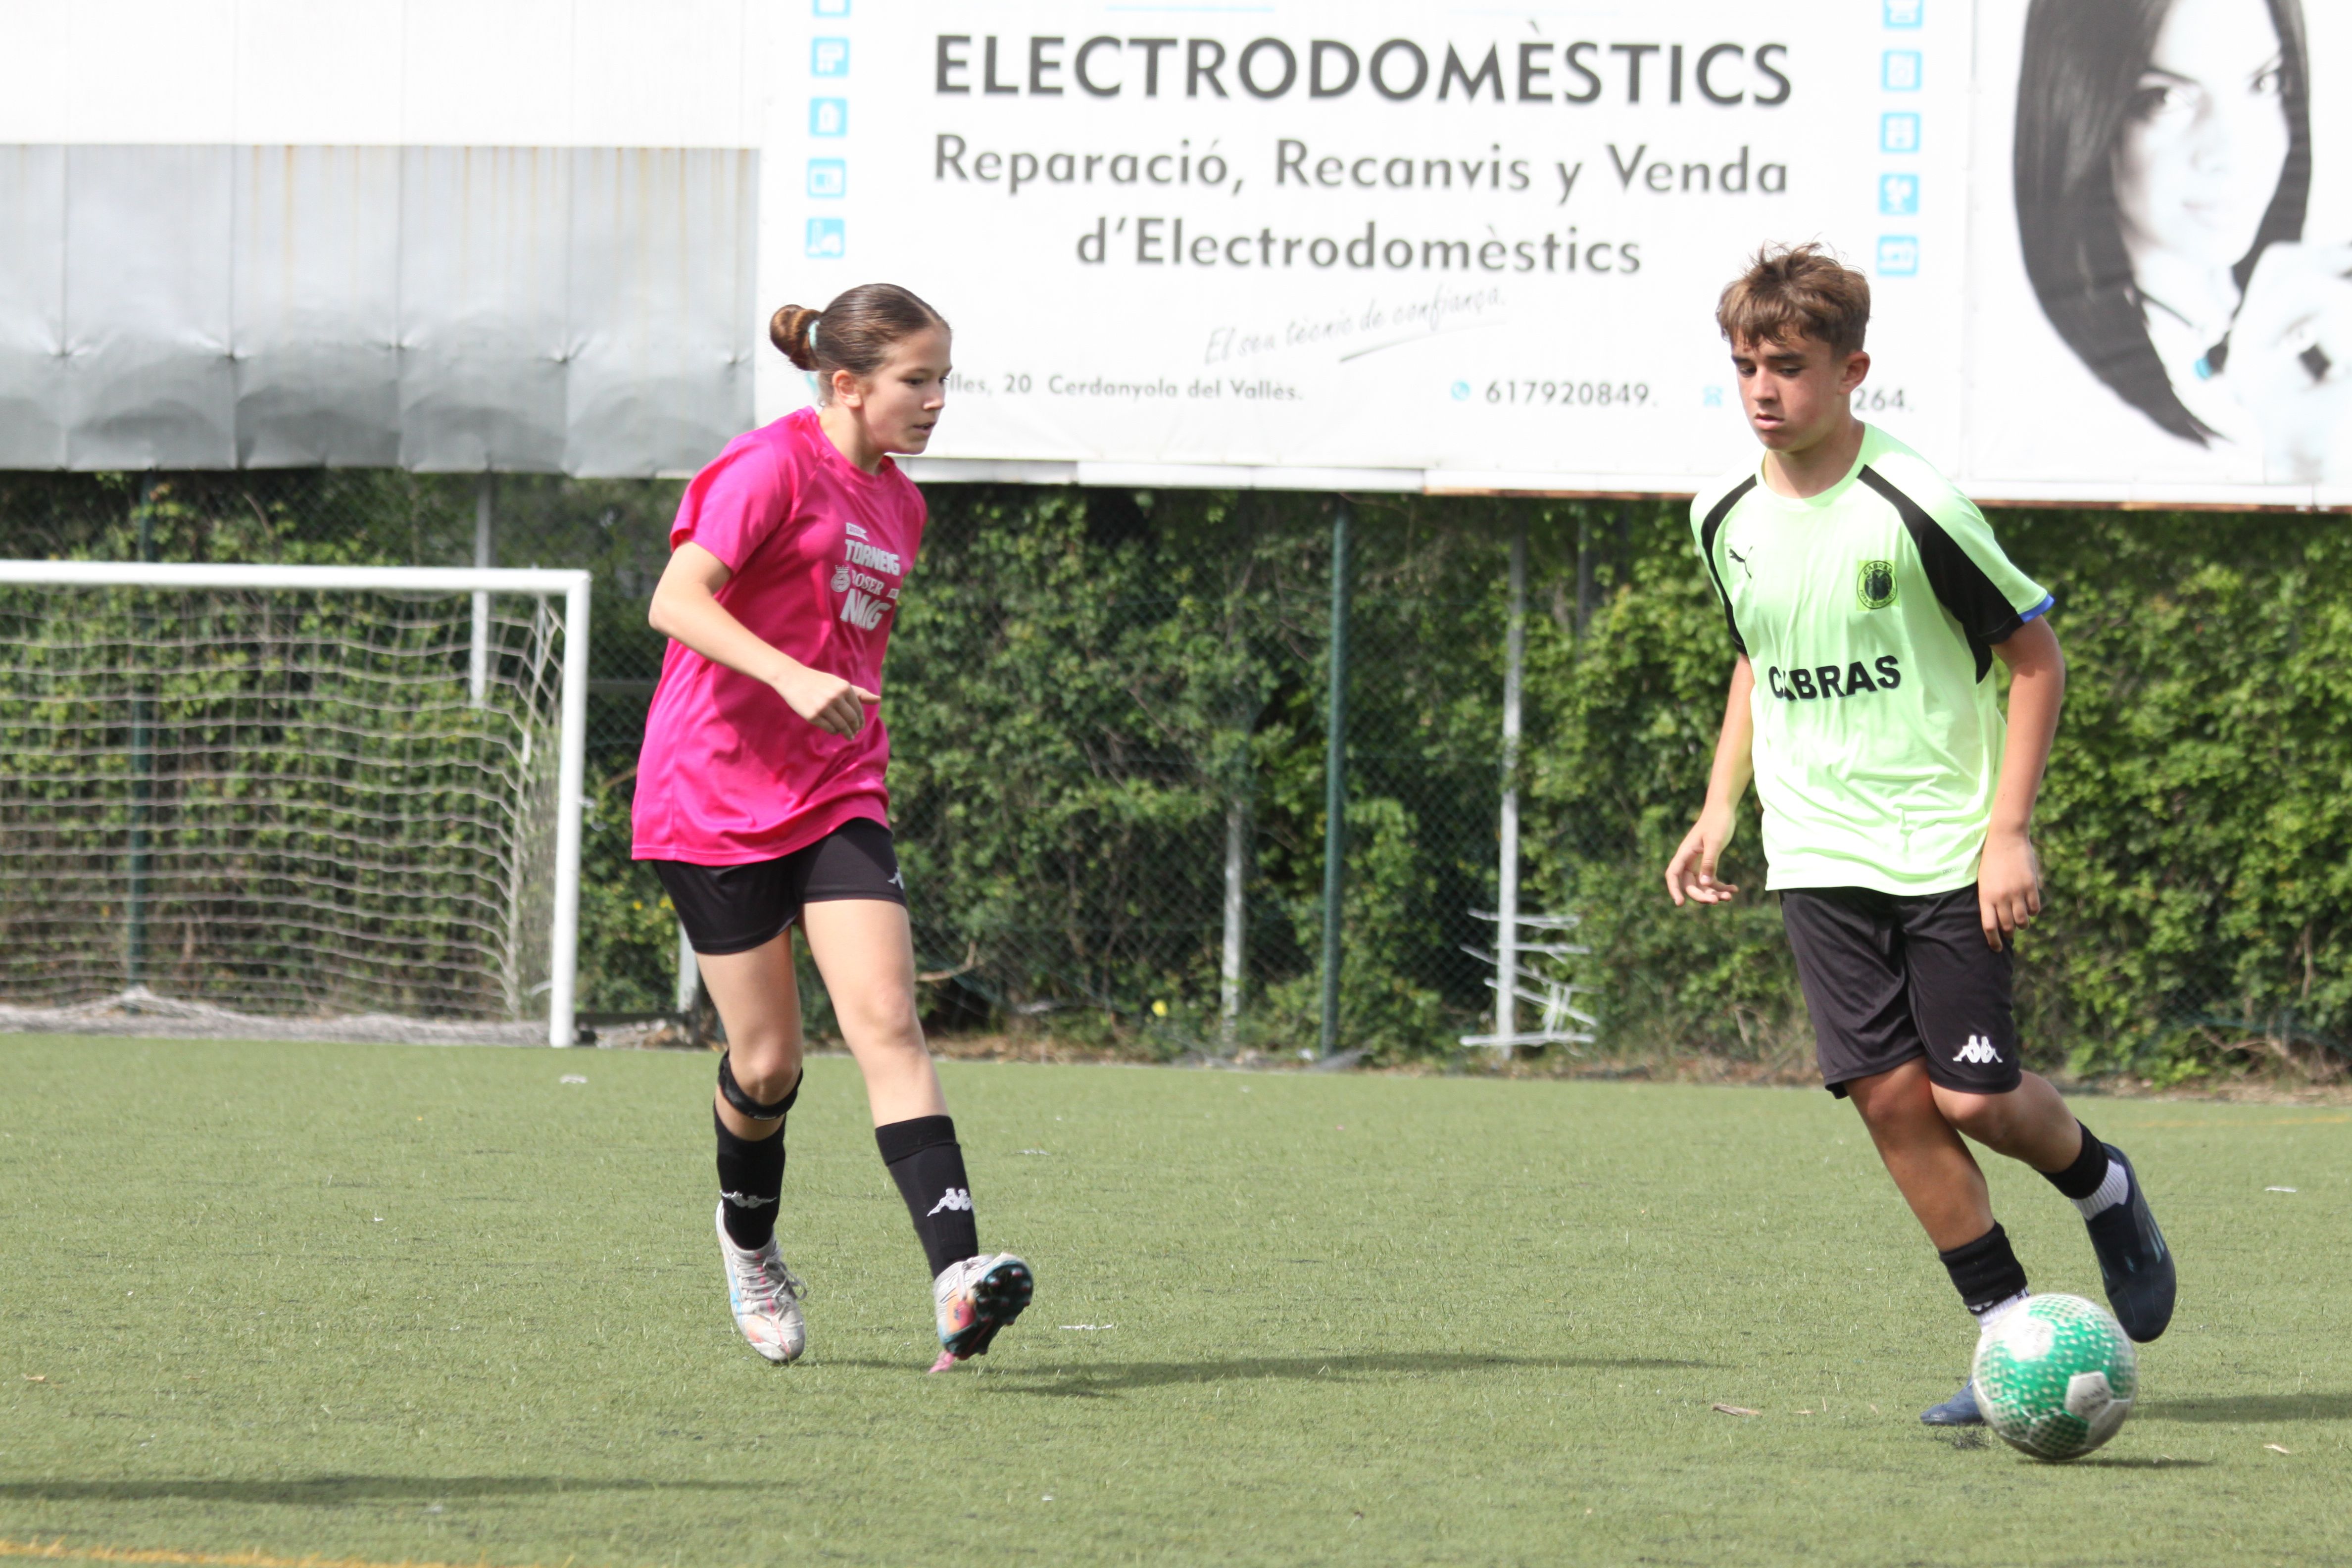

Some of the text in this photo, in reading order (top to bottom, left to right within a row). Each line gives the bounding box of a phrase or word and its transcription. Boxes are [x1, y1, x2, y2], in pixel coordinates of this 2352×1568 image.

[935, 21, 1792, 108] ELECTRODOMÈSTICS
[935, 133, 1787, 205] Reparació, Recanvis y Venda
[1359, 298, 1383, 332] de
[1004, 372, 1033, 394] 20
[1047, 373, 1179, 402] Cerdanyola
[1187, 378, 1222, 398] del
[1484, 380, 1658, 407] 617920849.
[1863, 562, 1893, 575] CABRAS
